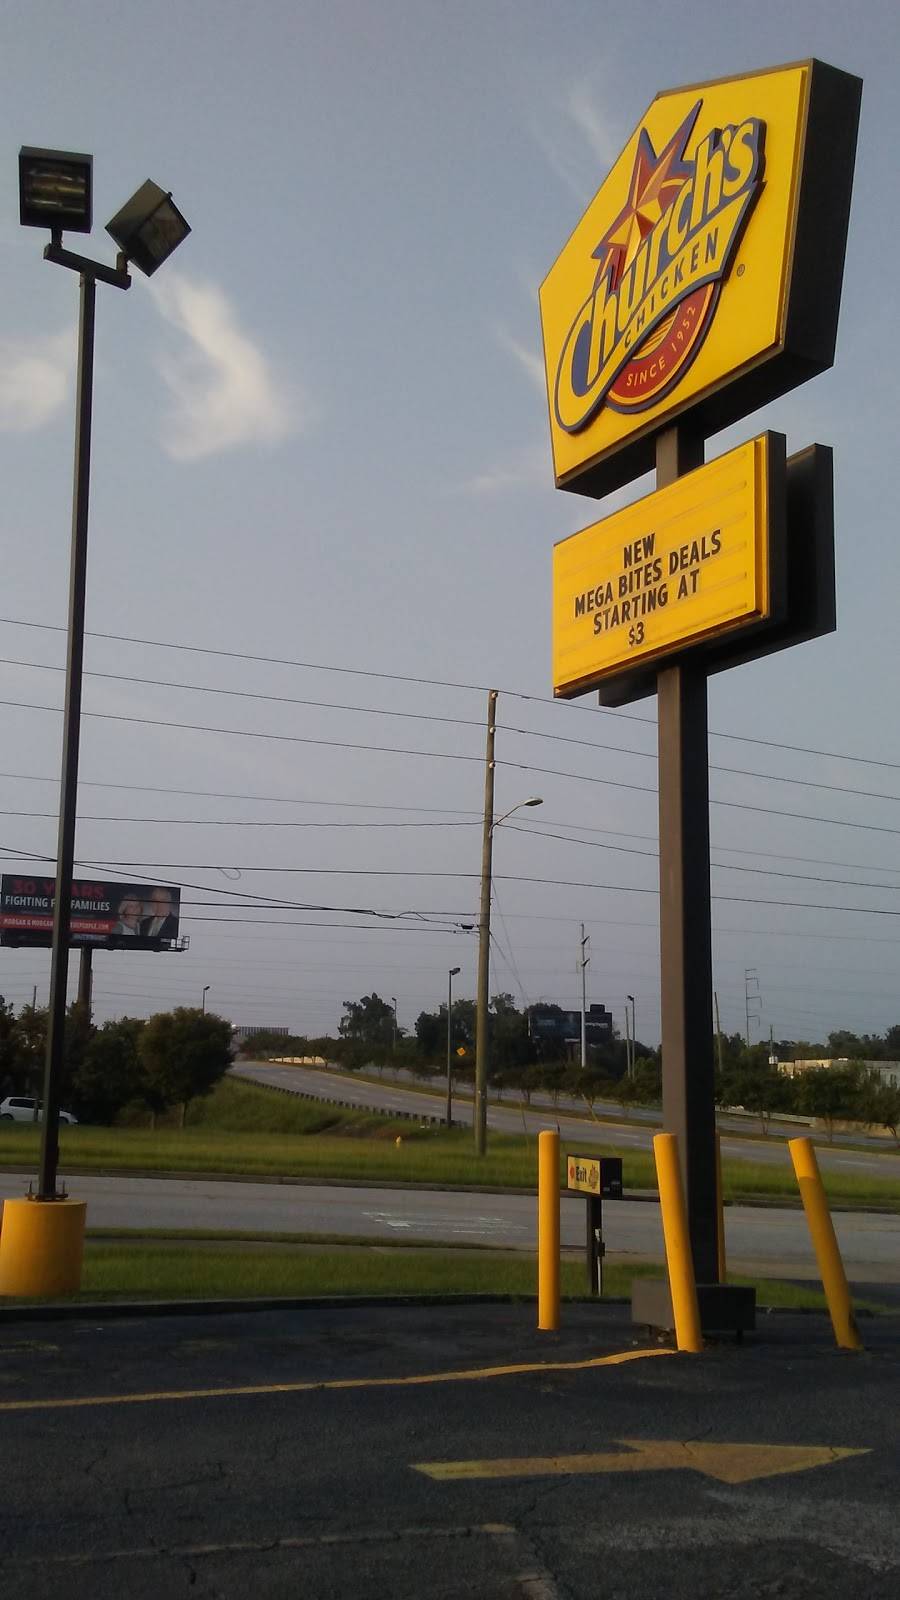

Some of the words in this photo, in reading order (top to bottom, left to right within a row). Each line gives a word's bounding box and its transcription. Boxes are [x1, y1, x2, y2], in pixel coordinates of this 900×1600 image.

[556, 116, 766, 432] Church's
[624, 226, 719, 348] CHICKEN
[626, 356, 667, 388] SINCE
[671, 305, 697, 353] 1952
[574, 582, 613, 618] MEGA
[618, 558, 663, 596] BITES
[669, 529, 722, 575] DEALS
[623, 533, 656, 568] NEW
[593, 583, 669, 635] STARTING
[678, 569, 700, 600] AT
[628, 622, 645, 646] $3
[5, 895, 48, 908] FIGHTING
[70, 899, 111, 912] FAMILIES
[575, 1164, 588, 1183] Exit
